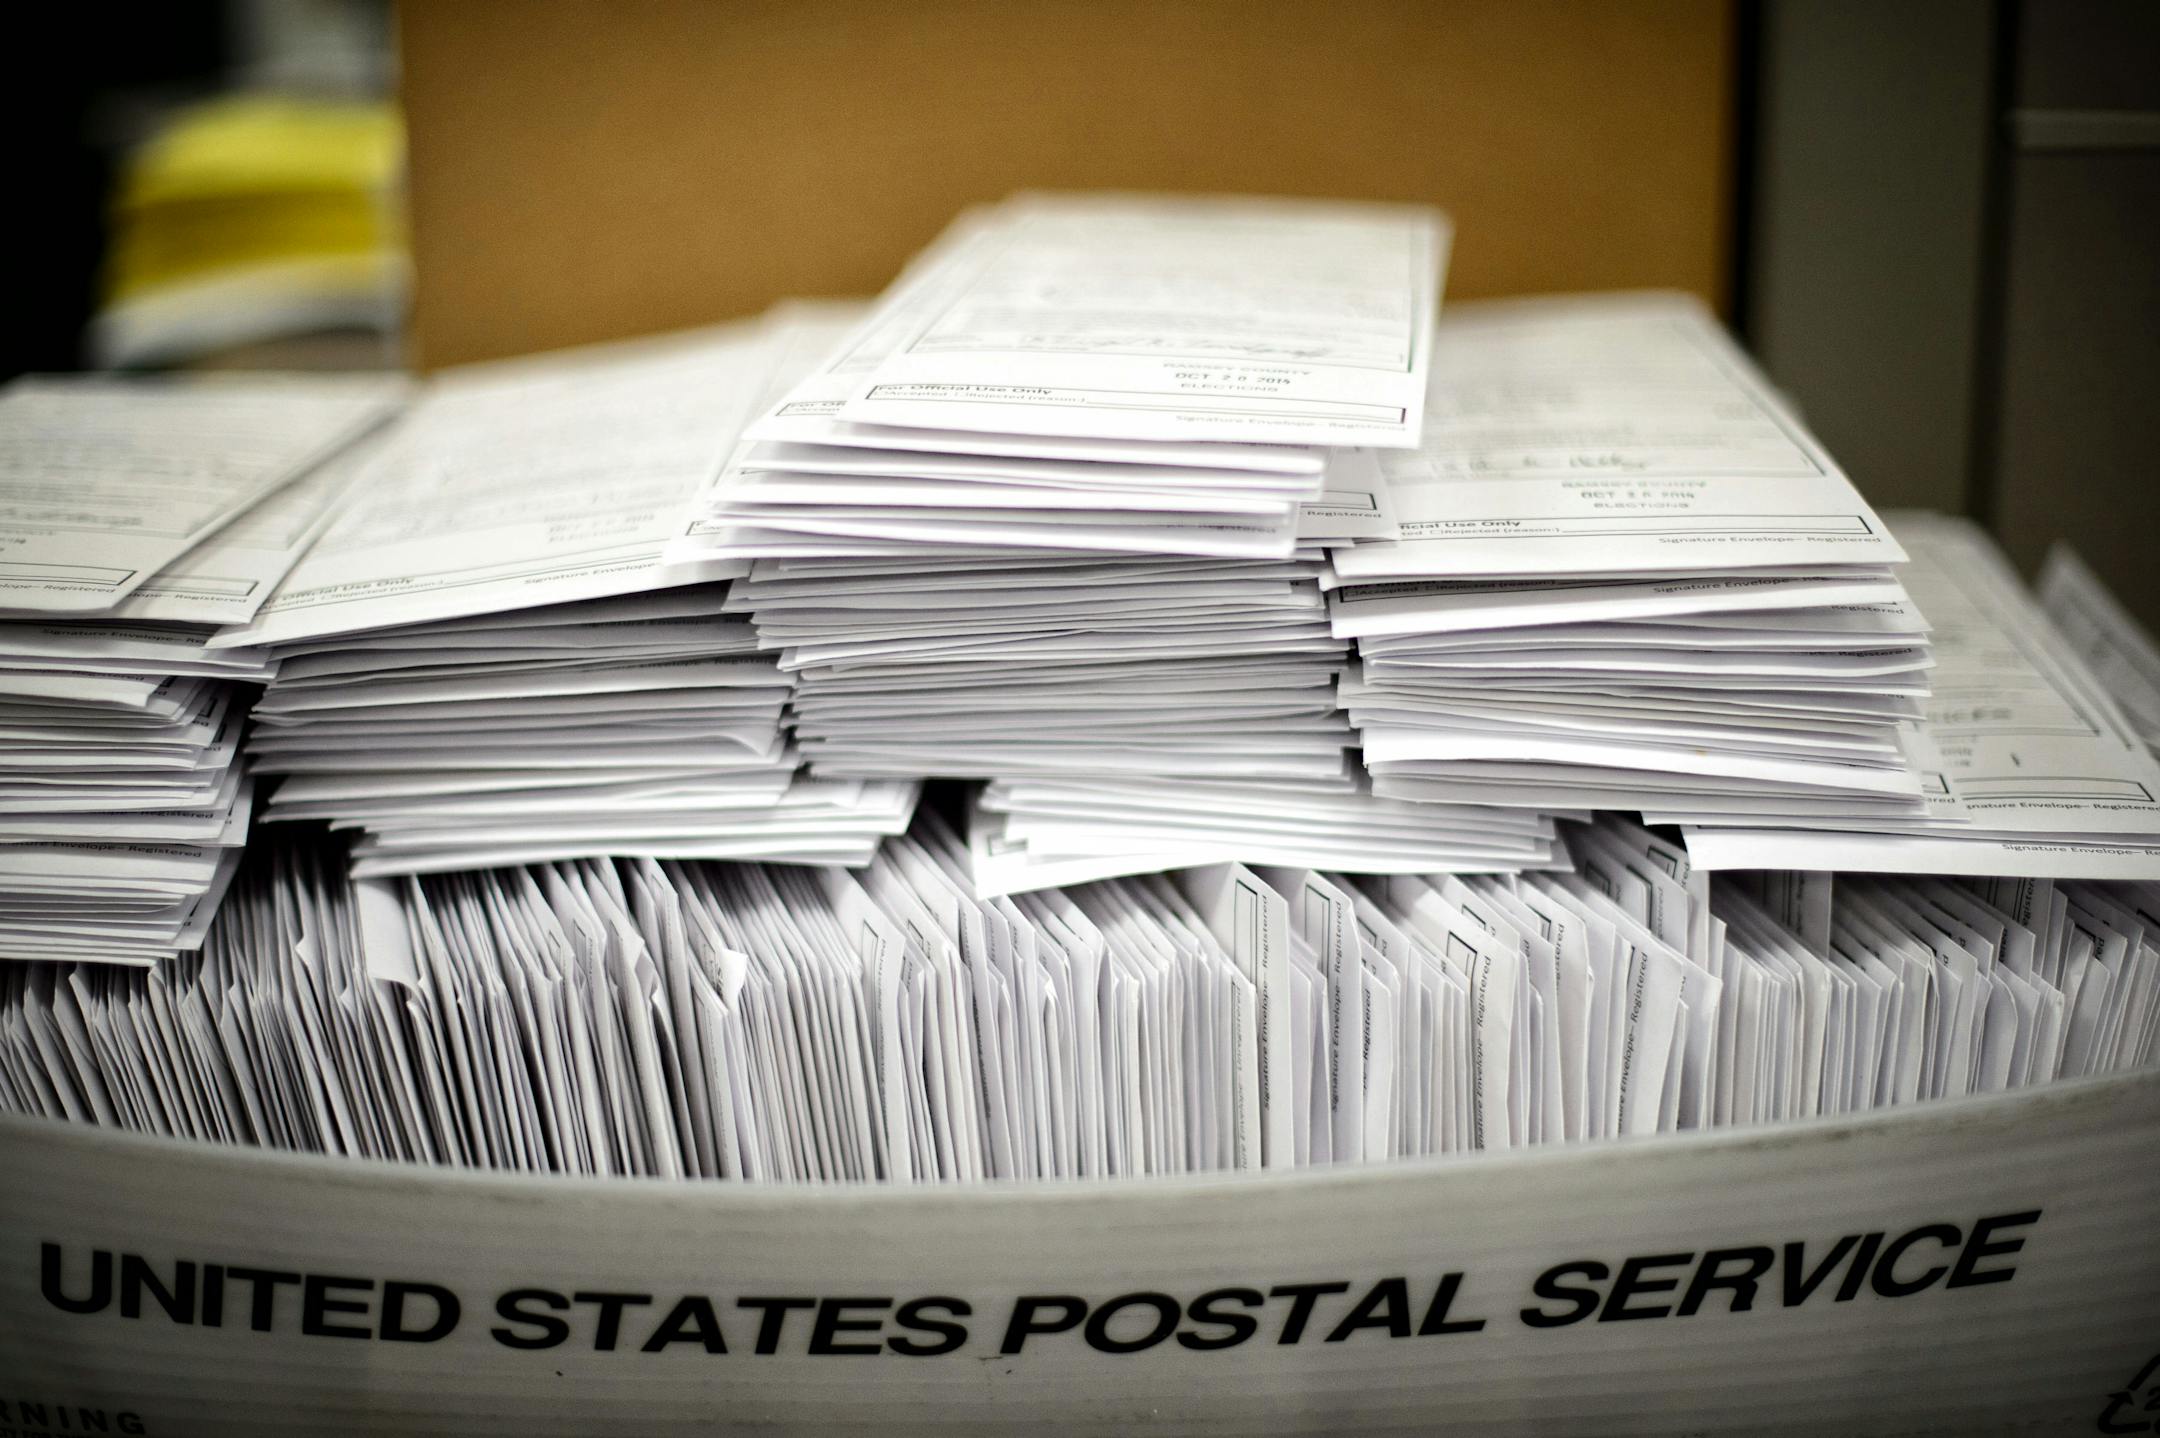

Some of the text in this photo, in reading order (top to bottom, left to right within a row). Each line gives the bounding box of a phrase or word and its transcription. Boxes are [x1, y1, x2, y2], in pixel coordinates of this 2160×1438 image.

[1174, 372, 1211, 380] OCT
[909, 383, 970, 392] Official
[975, 386, 1006, 394] Use
[1011, 386, 1053, 396] Only
[1180, 382, 1279, 392] ELECTIONS
[1306, 510, 1383, 519] Registered
[1445, 520, 1477, 529] Use
[1481, 520, 1521, 530] Only
[1658, 535, 1728, 545] Signature
[1806, 535, 1882, 545] Registered
[523, 569, 590, 586] Signature
[43, 583, 117, 595] Registered
[342, 582, 372, 594] Use
[375, 575, 415, 588] Only
[1653, 581, 1723, 594] Signature
[174, 592, 248, 604] Registered
[127, 844, 203, 858] Registered
[2001, 843, 2068, 854] Signature
[1260, 895, 1270, 969] Registered
[1332, 901, 1344, 975] Registered
[1475, 955, 1493, 1028] Registered
[1630, 951, 1649, 1023] Registered
[1362, 988, 1372, 1060] Registered
[41, 1209, 2043, 1357] UNITED STATES POSTAL SERVICE
